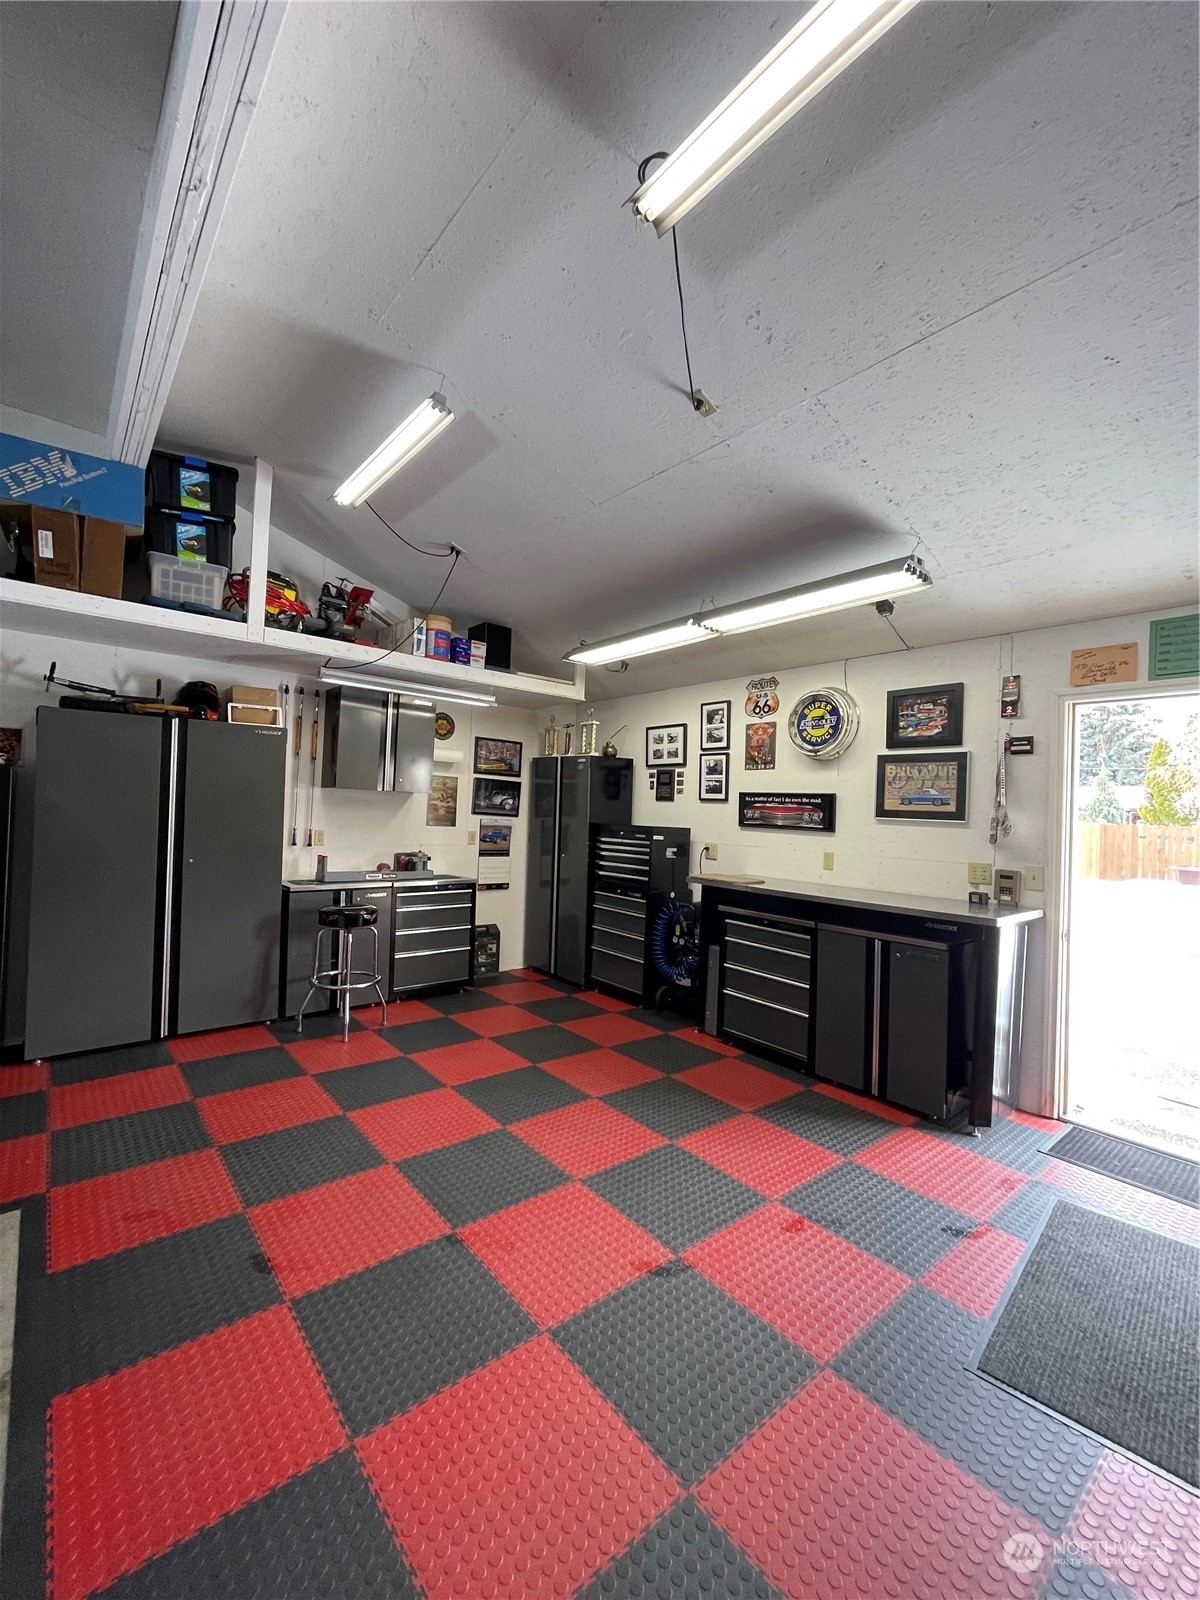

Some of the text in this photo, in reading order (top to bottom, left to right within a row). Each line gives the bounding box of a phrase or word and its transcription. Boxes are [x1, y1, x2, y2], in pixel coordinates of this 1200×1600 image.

[0, 450, 67, 497] IBM
[751, 681, 774, 691] ROUTE
[752, 699, 772, 716] 66
[803, 701, 833, 716] SUPER
[1006, 705, 1013, 713] 2
[802, 728, 834, 743] SERVICE
